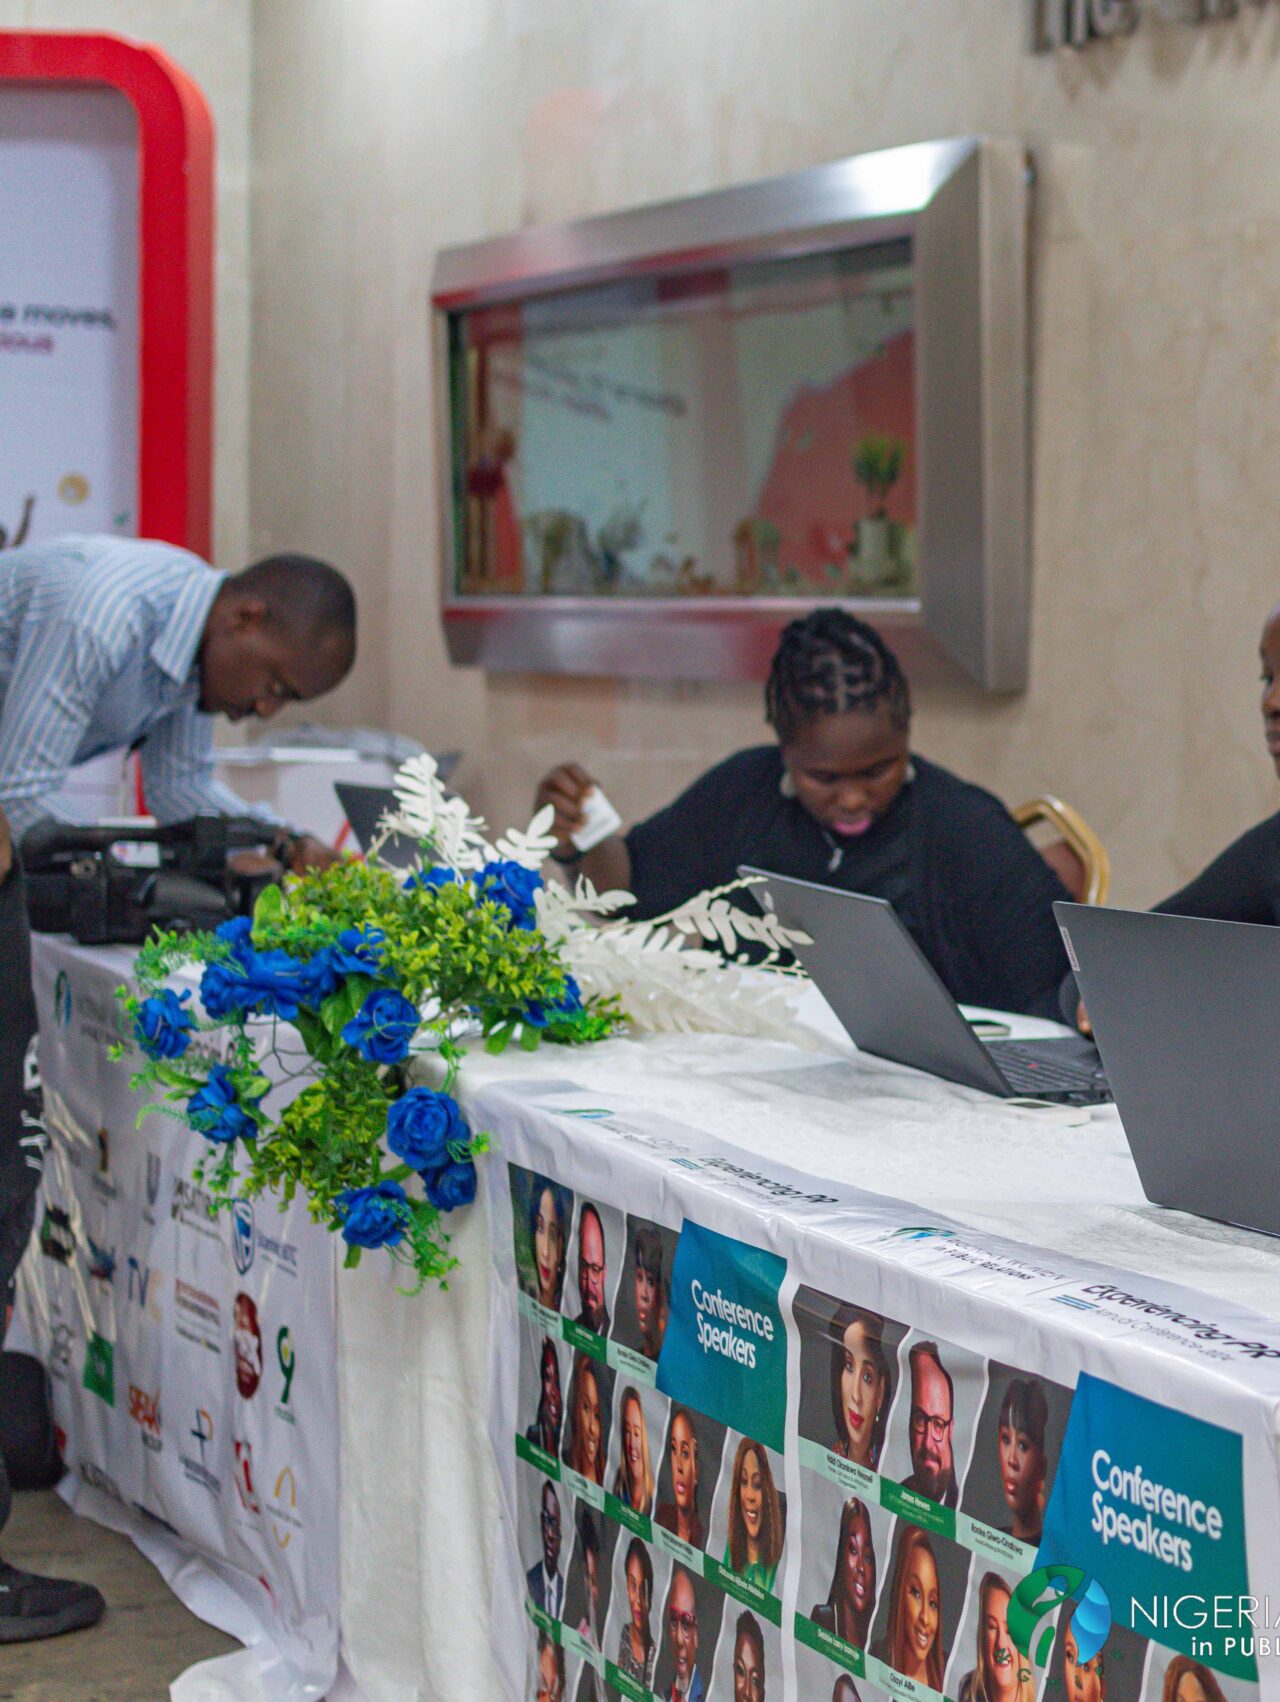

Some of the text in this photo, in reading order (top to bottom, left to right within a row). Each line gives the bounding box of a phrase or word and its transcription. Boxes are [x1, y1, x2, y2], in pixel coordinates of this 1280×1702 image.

[690, 1279, 775, 1342] Conference
[696, 1312, 757, 1370] Speakers
[1081, 1284, 1235, 1341] Experiencing
[1091, 1449, 1223, 1540] Conference
[1091, 1491, 1193, 1572] Speakers
